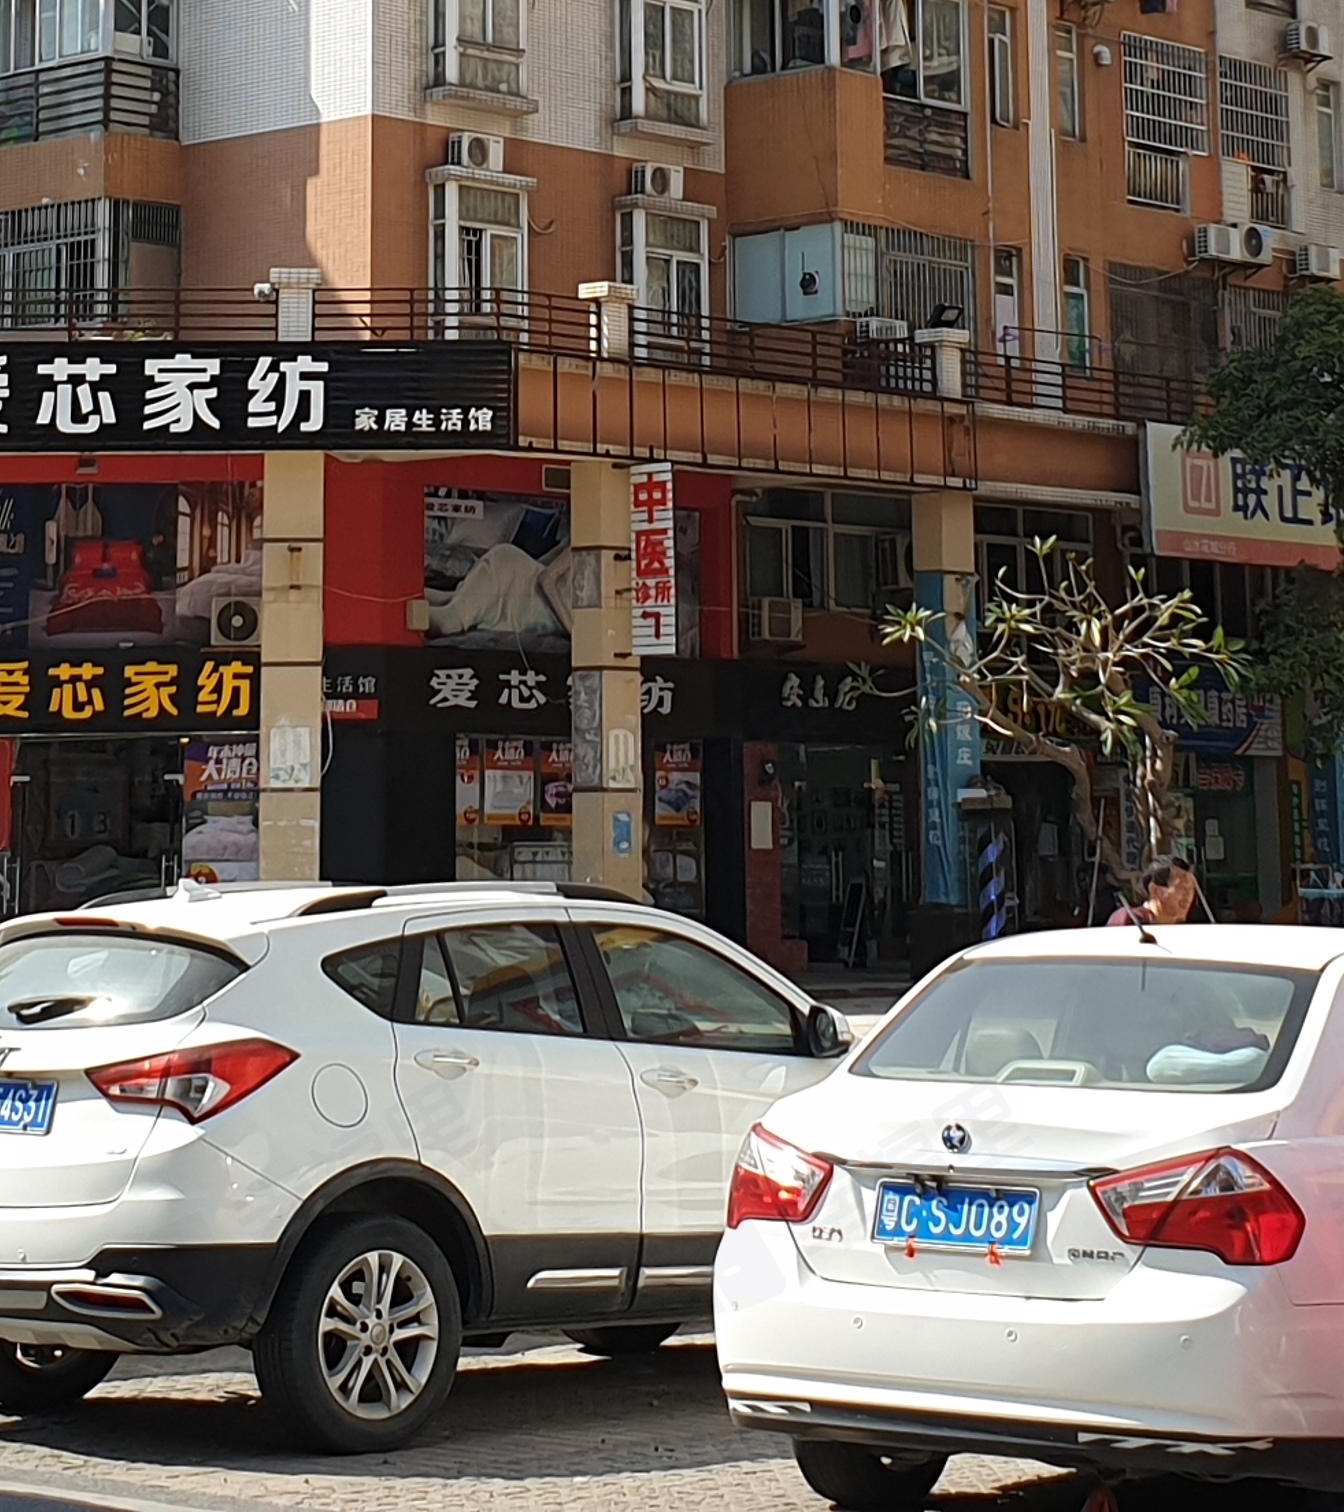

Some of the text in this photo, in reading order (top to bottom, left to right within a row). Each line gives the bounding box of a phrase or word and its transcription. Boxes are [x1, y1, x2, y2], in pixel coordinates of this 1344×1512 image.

[354, 407, 494, 433] 家居生活馆
[632, 474, 671, 579] 中医
[634, 580, 672, 606] 诊所
[428, 667, 675, 717] 爱芯纺
